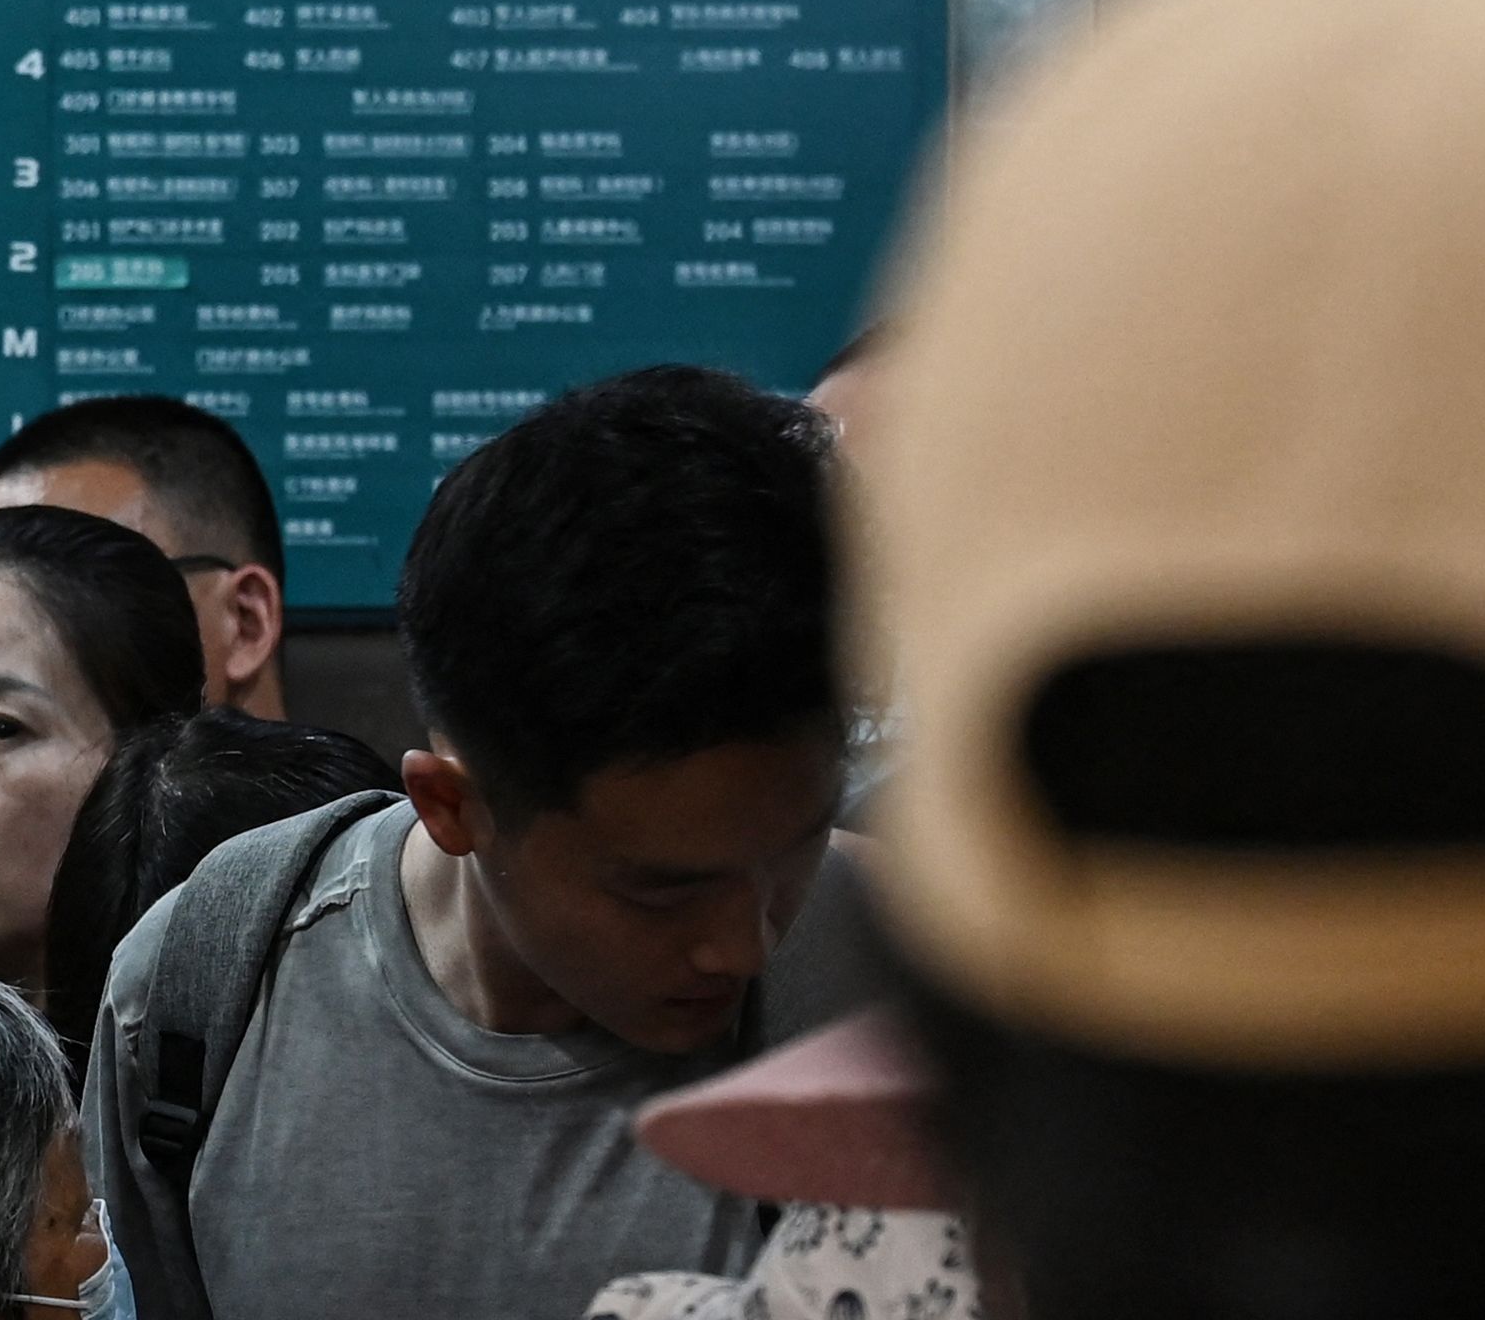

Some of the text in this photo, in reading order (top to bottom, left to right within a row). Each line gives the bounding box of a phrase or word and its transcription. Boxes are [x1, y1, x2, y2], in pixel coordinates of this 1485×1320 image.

[15, 49, 45, 80] 4
[13, 157, 40, 188] 3
[8, 241, 38, 273] 2
[2, 327, 38, 358] M
